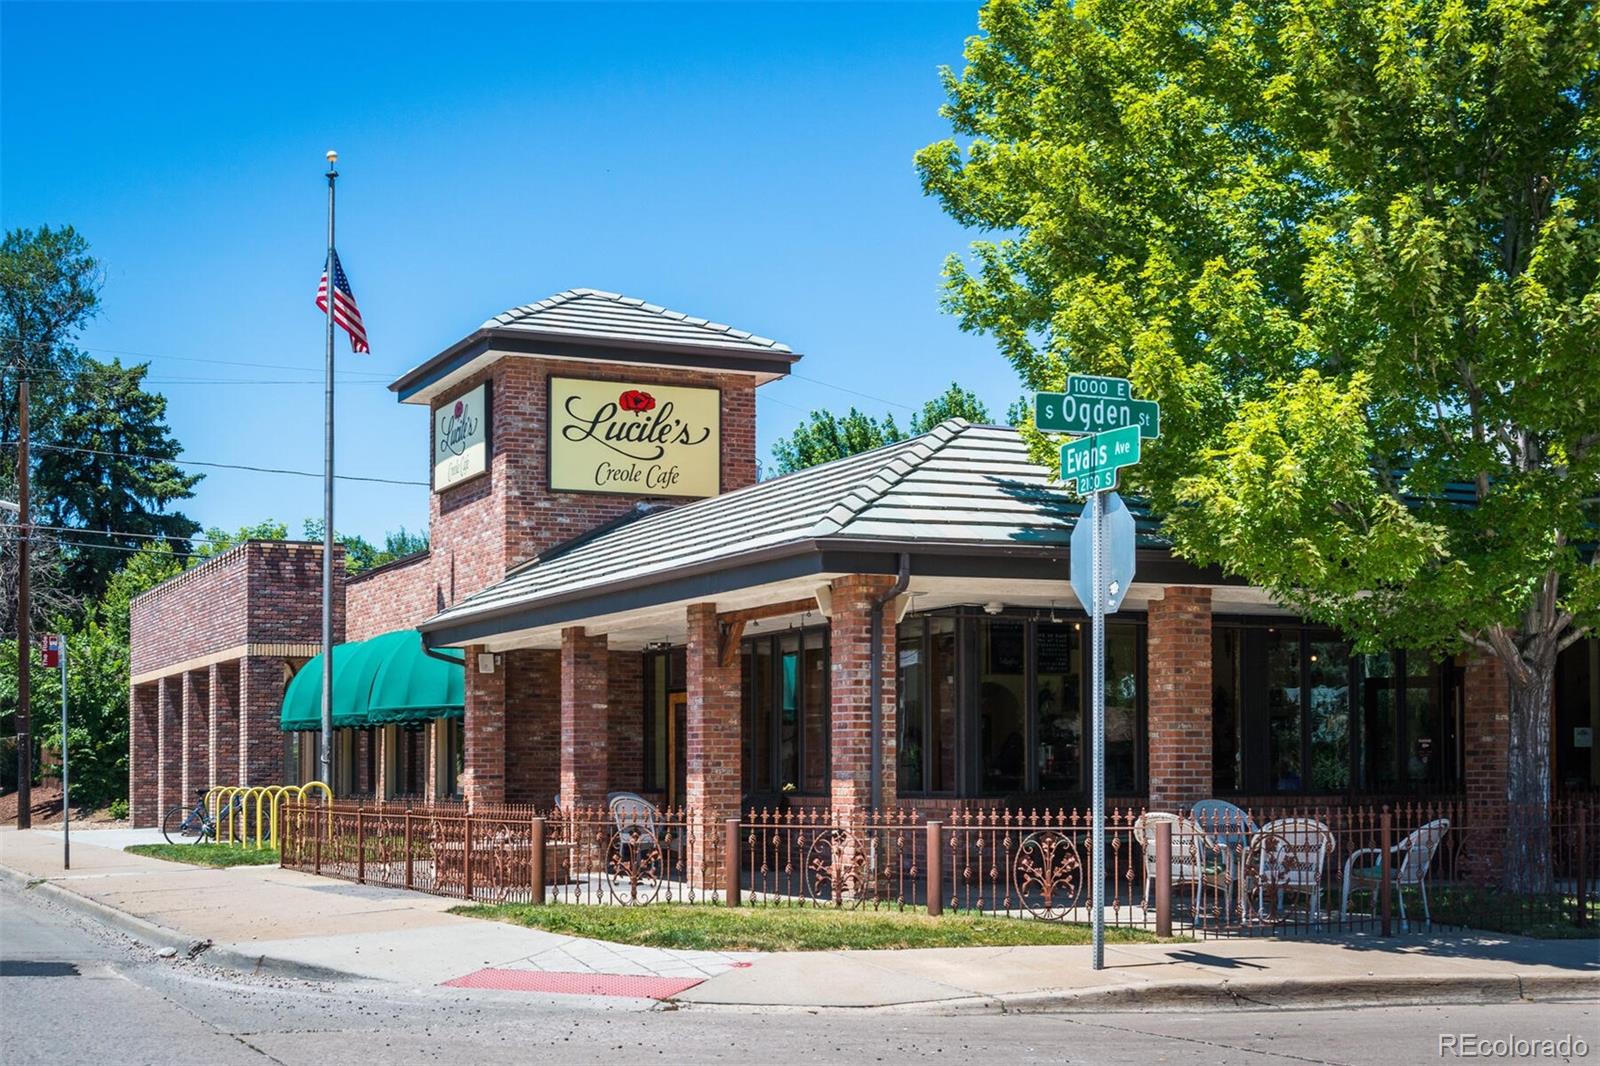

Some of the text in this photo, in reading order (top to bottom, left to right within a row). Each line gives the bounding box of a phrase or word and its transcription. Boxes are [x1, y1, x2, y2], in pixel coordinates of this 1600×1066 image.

[1074, 379, 1125, 396] 1000 E
[562, 396, 710, 461] Lucile's
[1045, 396, 1150, 431] S Ogden St
[1067, 441, 1130, 474] Evans Ave
[595, 461, 680, 489] Creole Cafe
[1080, 472, 1112, 492] 2100 S
